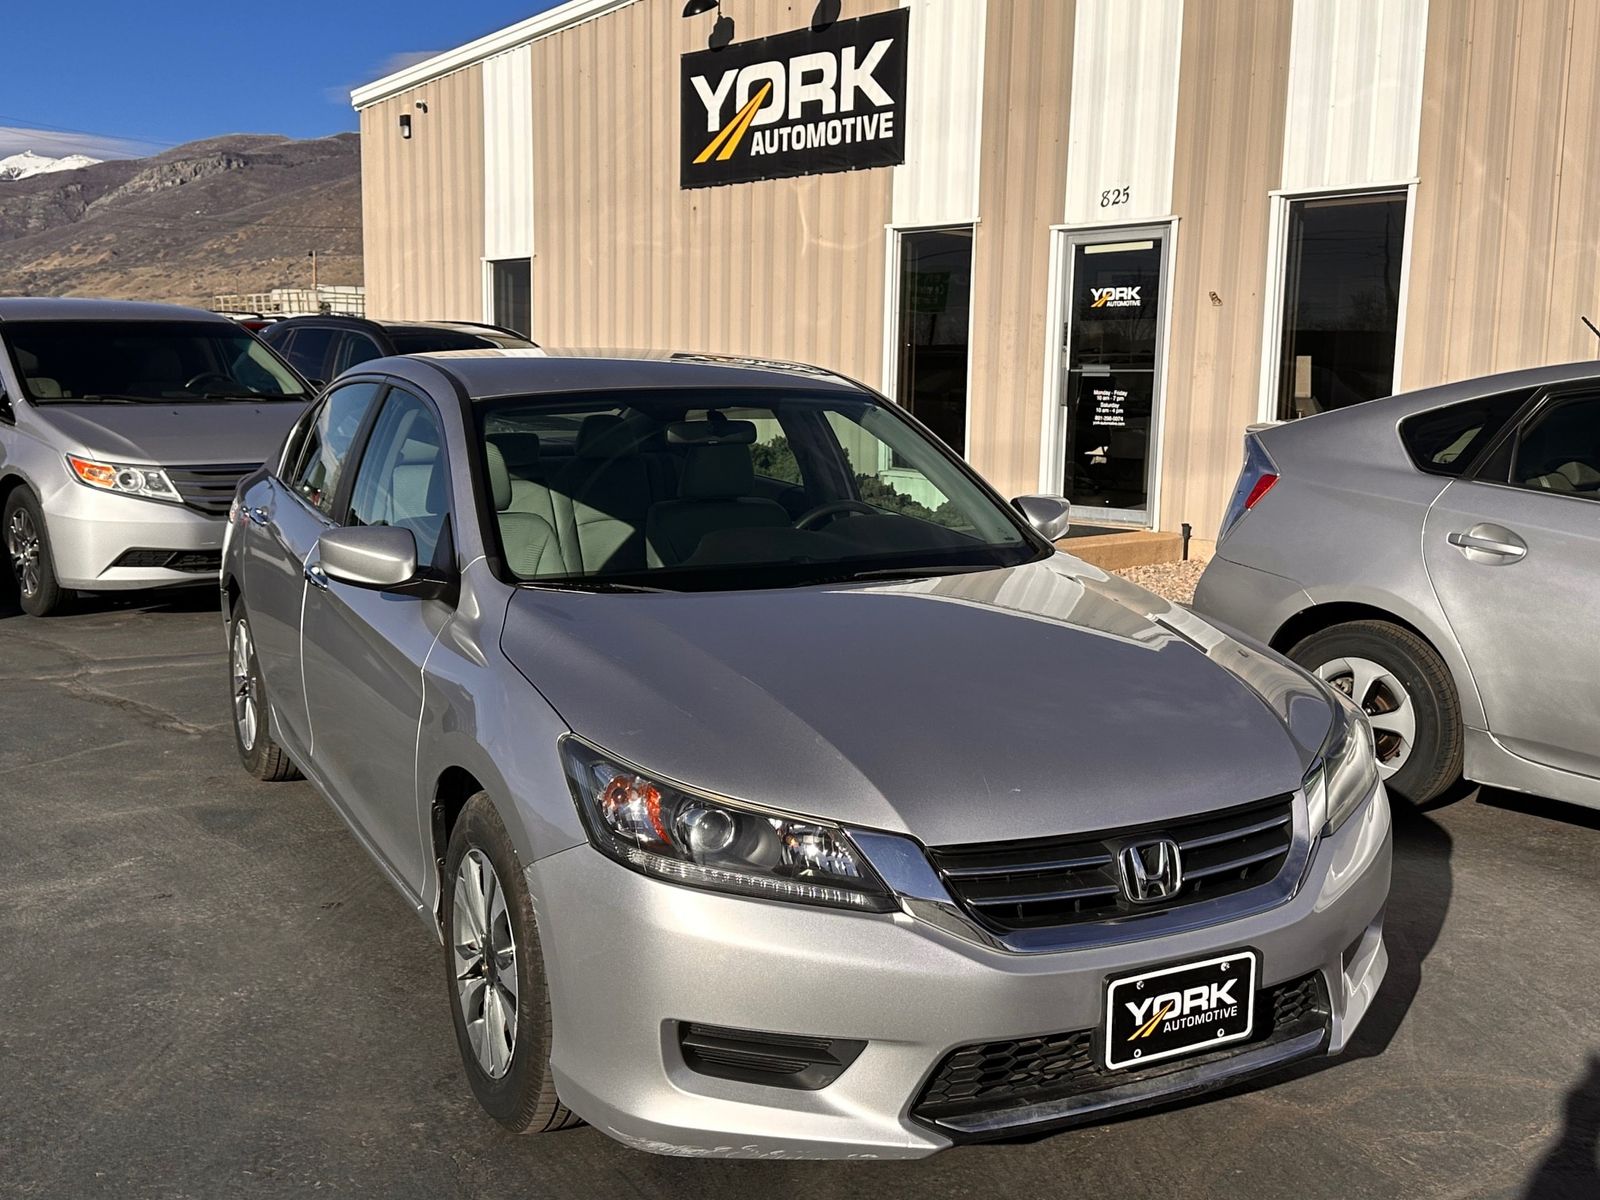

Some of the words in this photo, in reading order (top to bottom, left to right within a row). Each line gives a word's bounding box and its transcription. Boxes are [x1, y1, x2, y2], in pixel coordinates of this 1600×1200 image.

[690, 38, 896, 133] YORK
[750, 111, 894, 156] AUTOMOTIVE
[1100, 186, 1130, 208] 825
[1090, 286, 1141, 301] YORK
[1125, 978, 1238, 1026] YORK
[1163, 1005, 1238, 1033] AUTOMOTIVE
